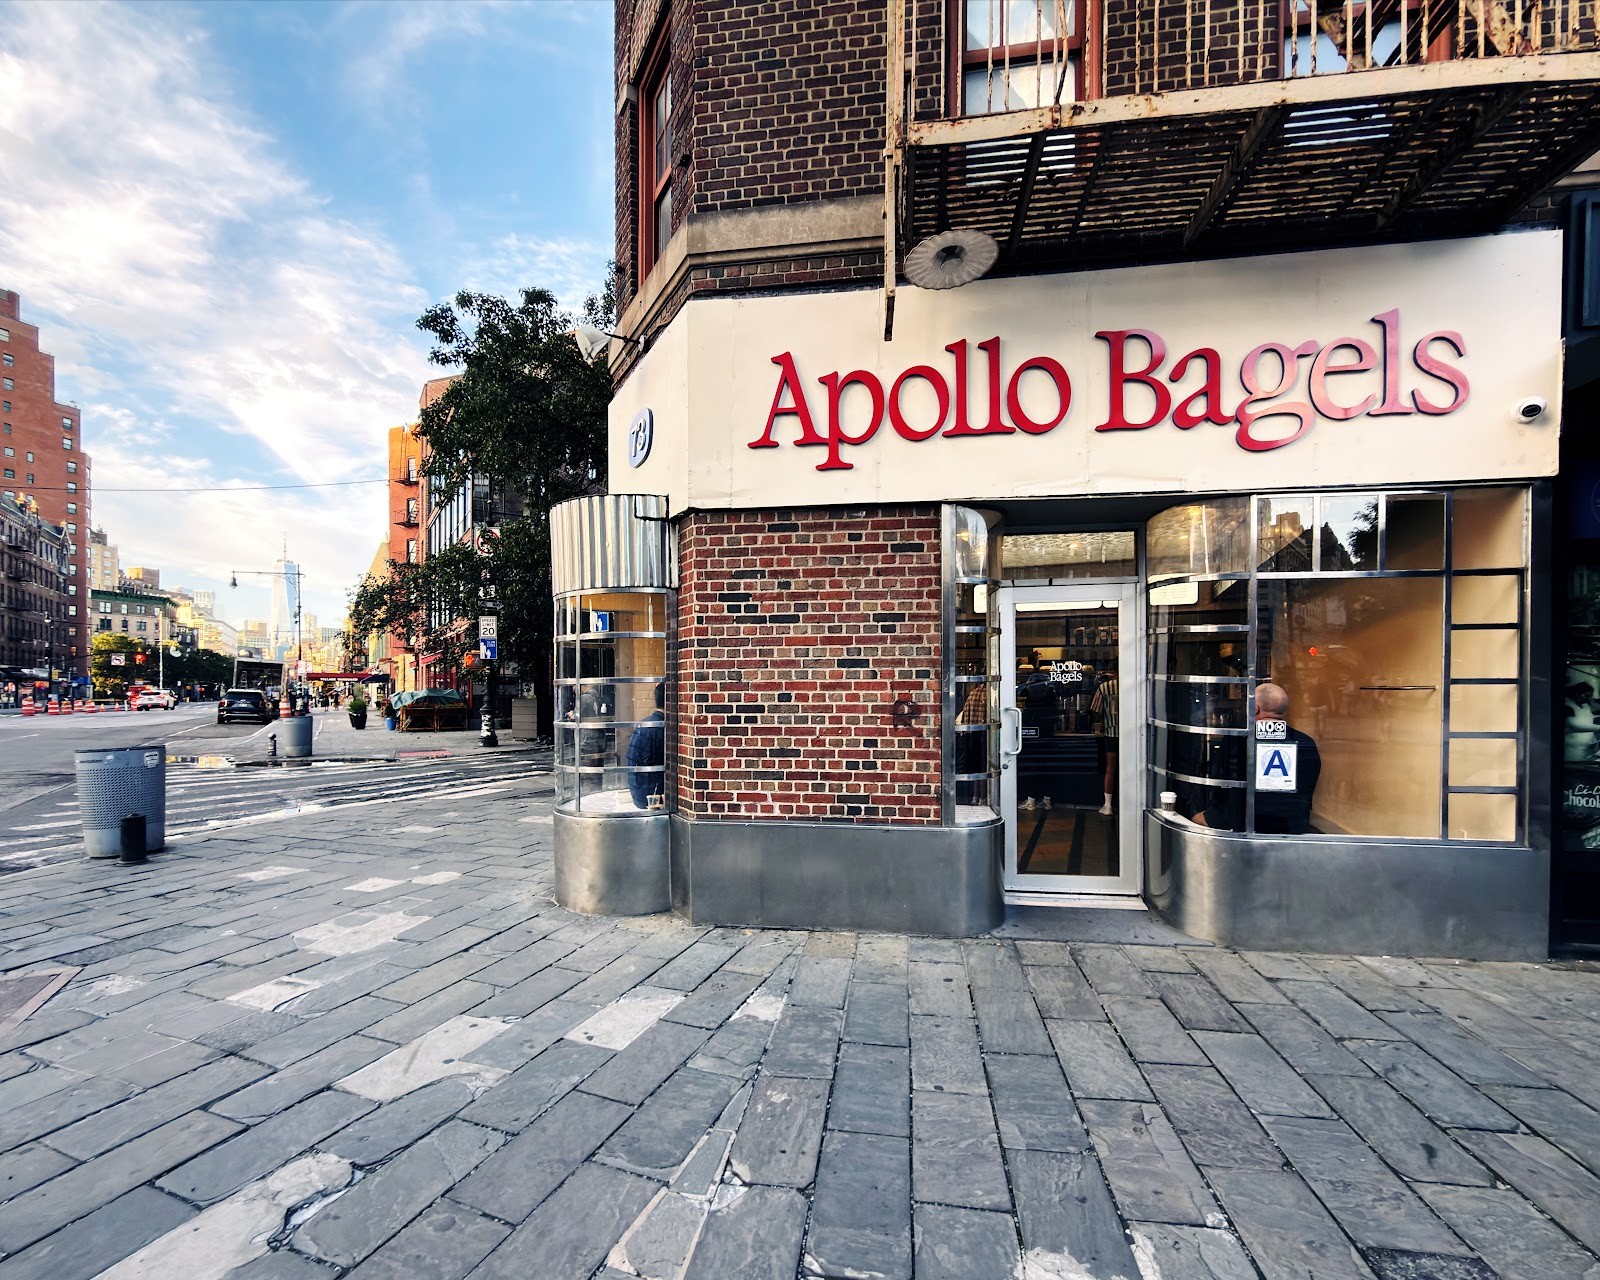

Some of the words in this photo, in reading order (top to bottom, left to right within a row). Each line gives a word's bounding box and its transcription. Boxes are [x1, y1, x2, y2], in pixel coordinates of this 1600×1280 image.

[748, 336, 1072, 471] Apollo
[1095, 308, 1471, 452] Bagels
[482, 627, 495, 635] 20
[1050, 661, 1082, 673] Apollo
[1050, 671, 1083, 684] Bagels
[1257, 722, 1274, 732] NO
[1263, 749, 1289, 777] A
